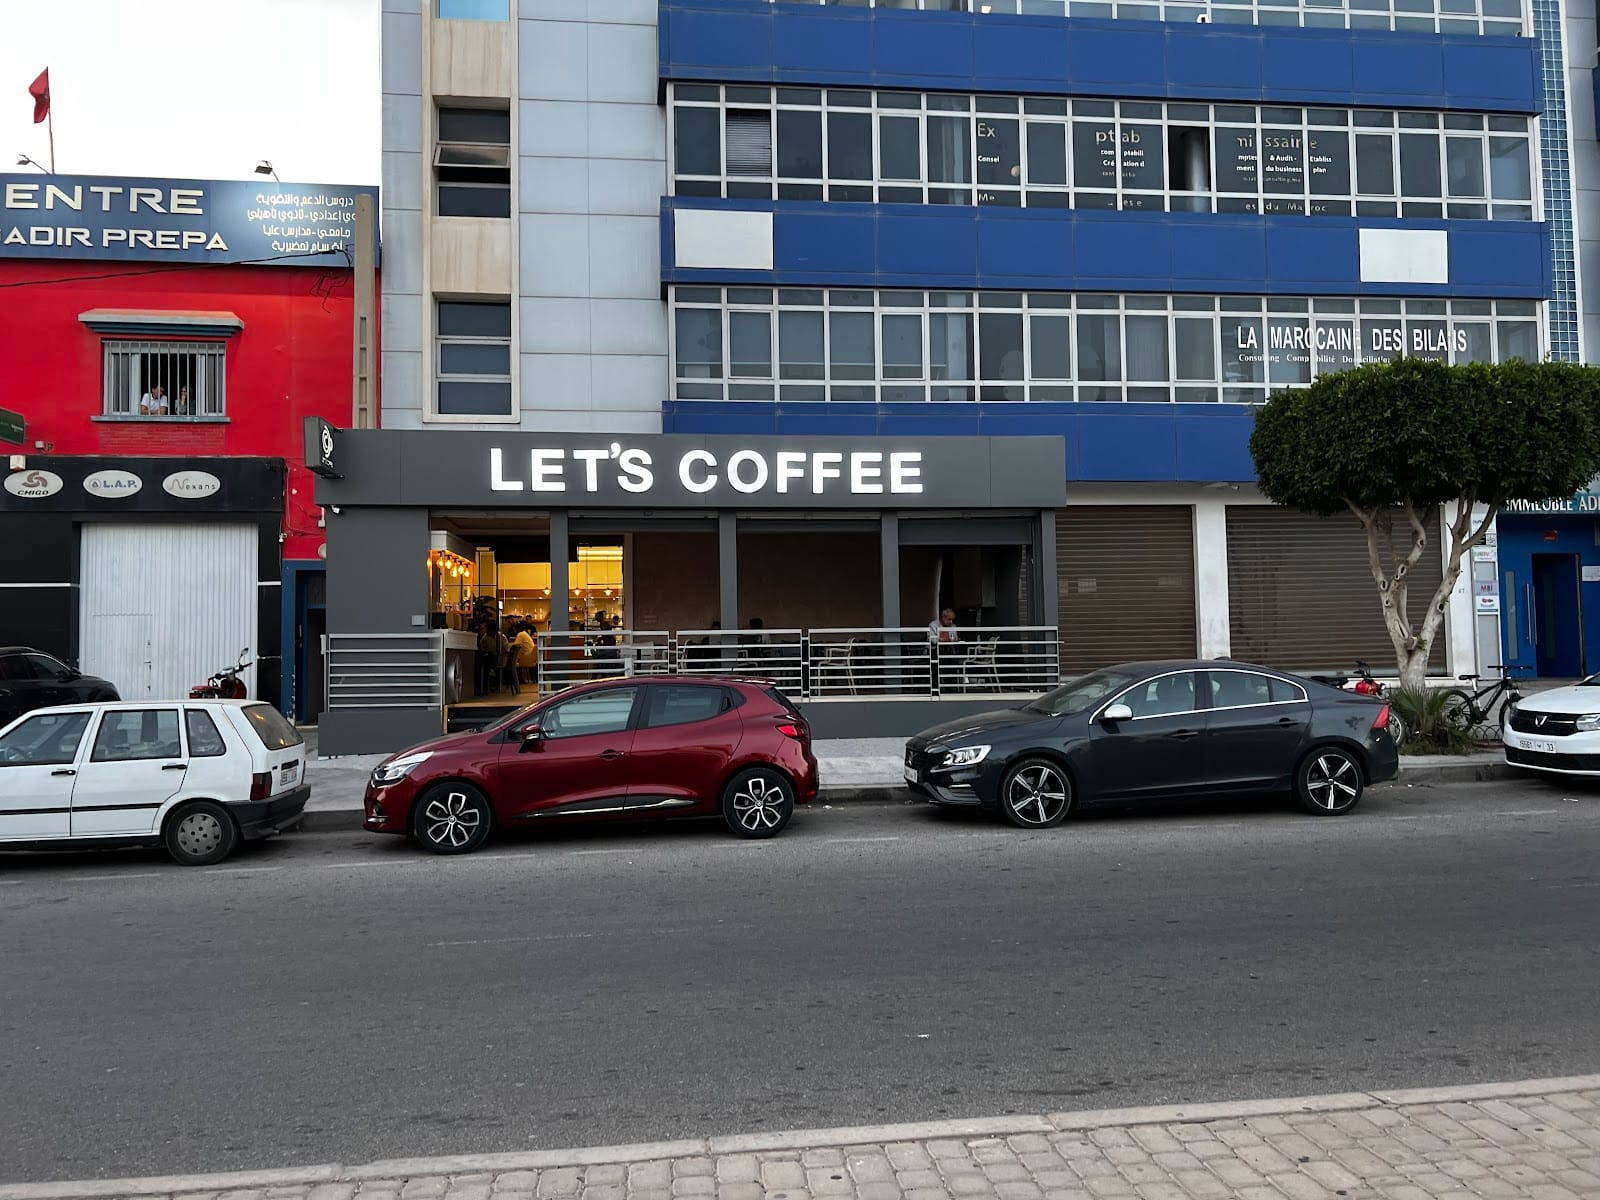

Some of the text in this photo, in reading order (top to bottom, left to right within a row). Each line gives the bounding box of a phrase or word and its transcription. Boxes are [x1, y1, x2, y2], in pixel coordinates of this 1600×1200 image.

[255, 192, 354, 207] دروس الدعم والتقوية
[0, 226, 229, 251] ADIR PREPA
[317, 227, 351, 239] جامعي
[1237, 326, 1258, 349] LA
[1372, 328, 1402, 351] DES
[490, 442, 924, 495] LET'S COFFEE
[103, 480, 137, 488] L.A.P.
[169, 478, 216, 490] Nexans
